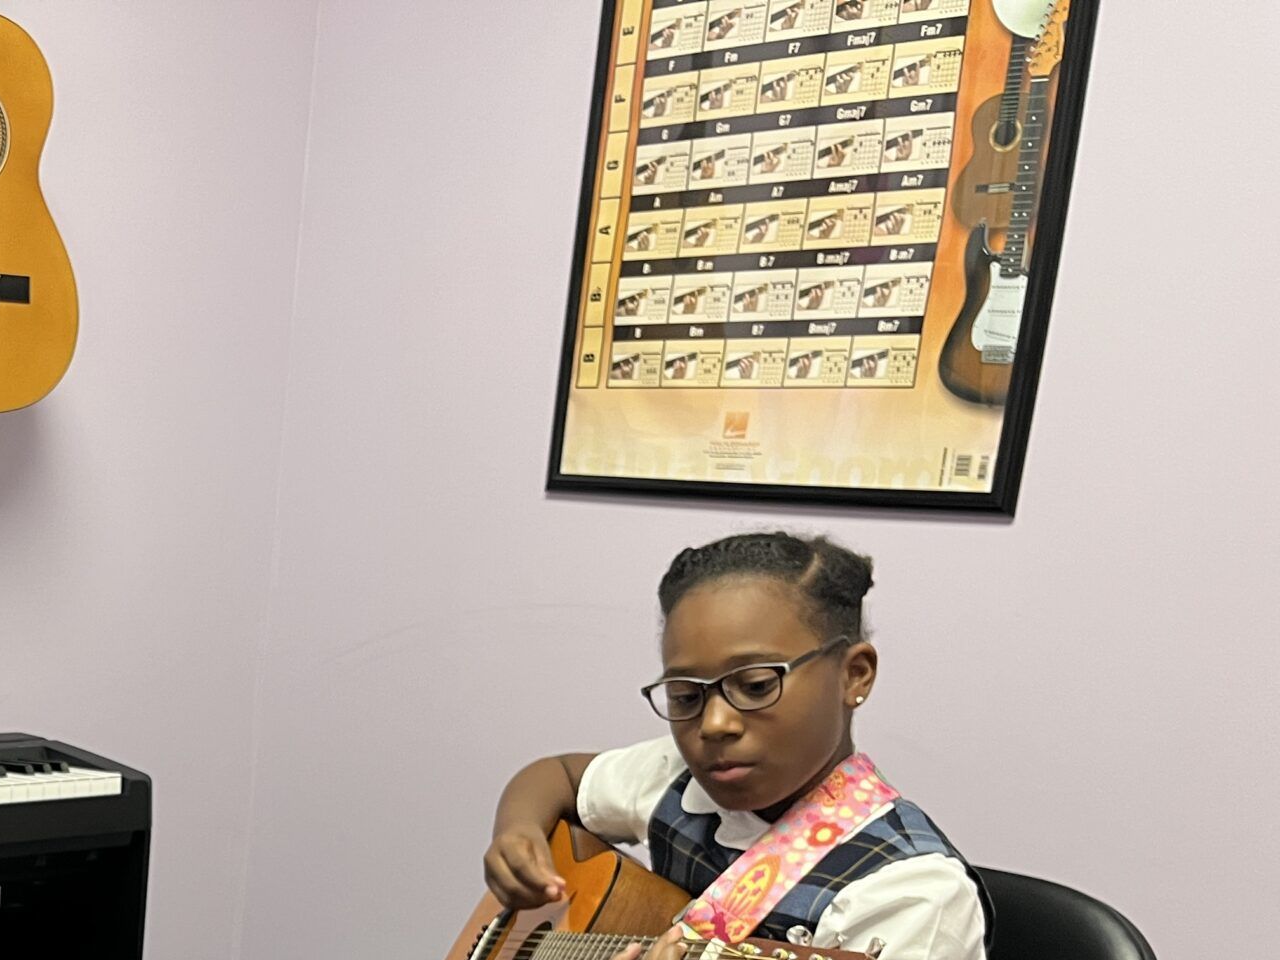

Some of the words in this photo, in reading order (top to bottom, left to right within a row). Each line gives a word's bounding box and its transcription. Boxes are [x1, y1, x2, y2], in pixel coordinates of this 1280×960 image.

[623, 26, 635, 36] E
[788, 42, 801, 54] F7
[847, 32, 877, 46] Fmaj7
[920, 23, 943, 37] Fm7
[836, 106, 867, 121] Gmaj7
[910, 99, 933, 112] Gm7
[828, 179, 859, 194] Amaj7
[901, 174, 924, 187] Am7
[599, 225, 611, 236] A
[808, 322, 837, 336] Bmaj7
[877, 319, 900, 332] Bm7
[583, 353, 595, 363] B
